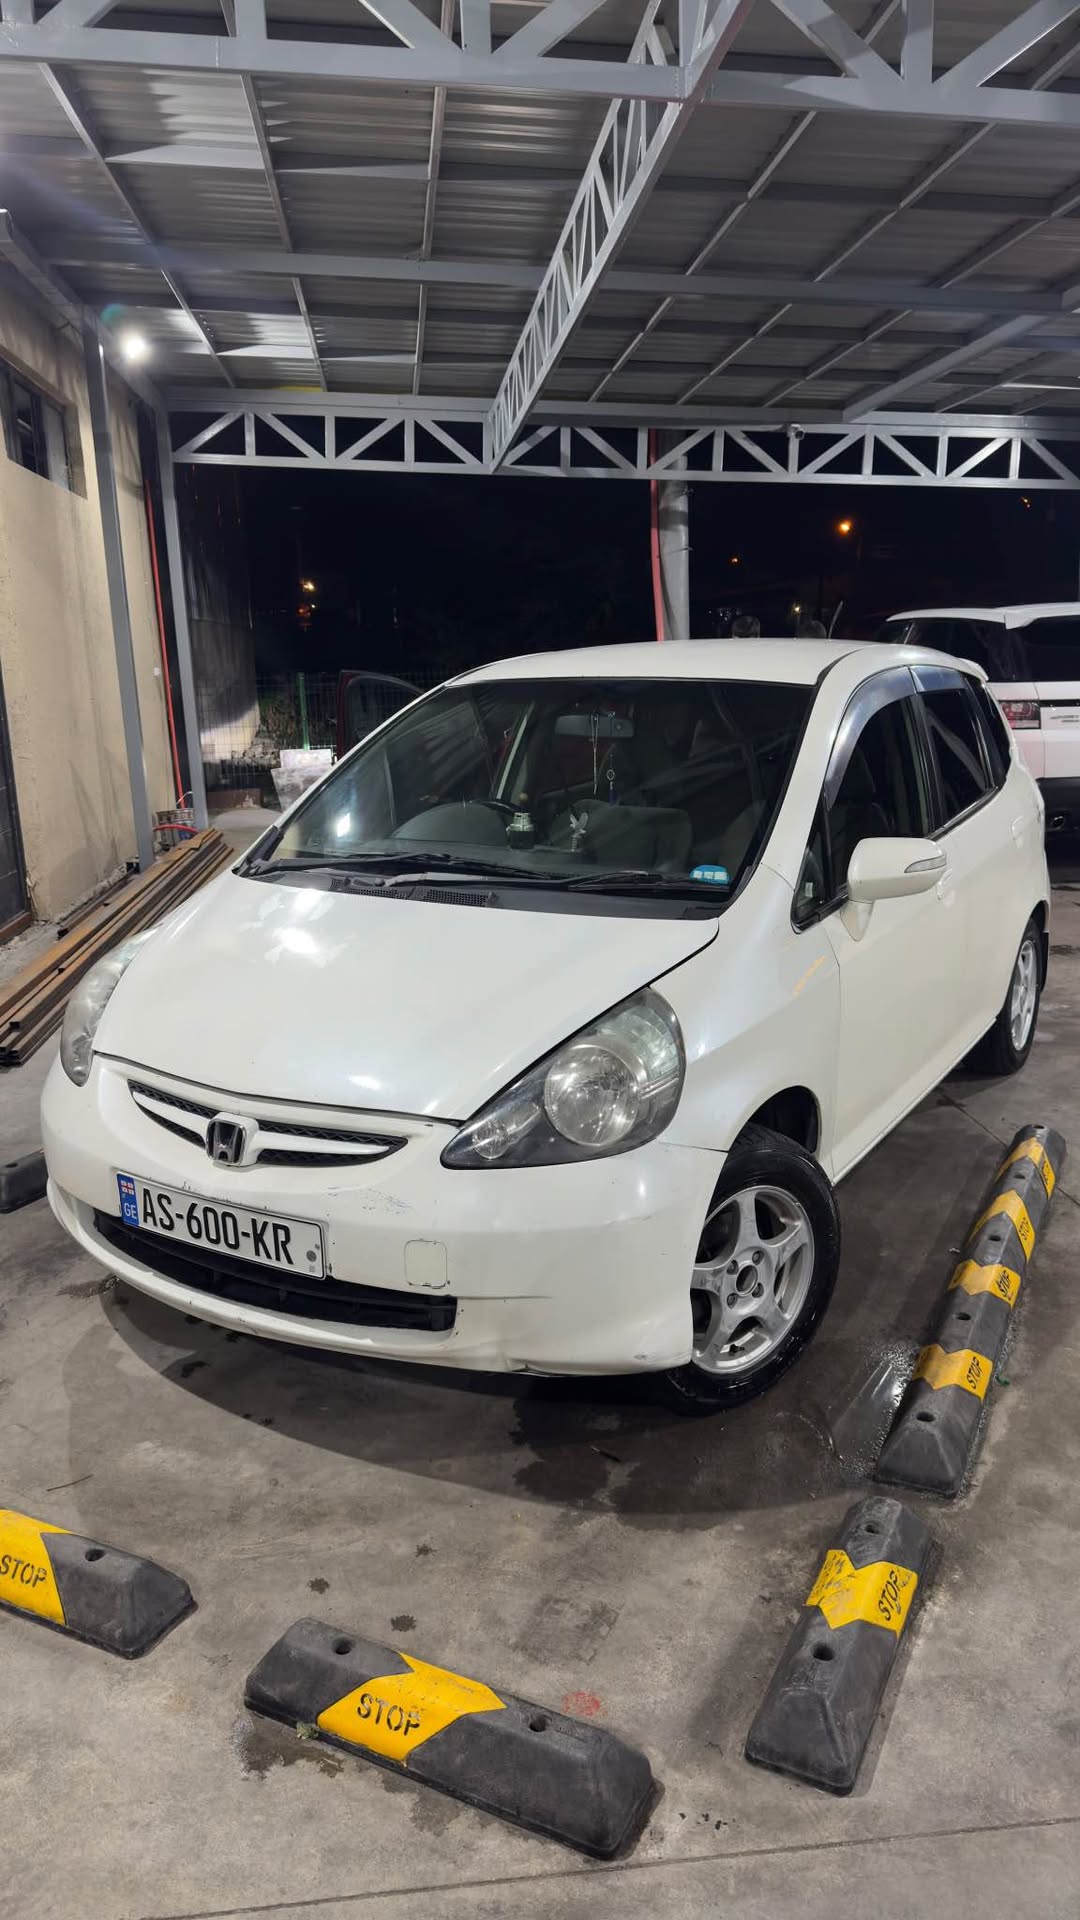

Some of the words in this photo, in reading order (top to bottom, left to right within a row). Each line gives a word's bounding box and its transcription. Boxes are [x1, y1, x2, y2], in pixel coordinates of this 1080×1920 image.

[124, 1202, 137, 1219] GE
[142, 1188, 294, 1265] AS-600-KR
[966, 1356, 983, 1389] STOP
[0, 1554, 47, 1588] STOP
[878, 1570, 902, 1621] STOP
[357, 1693, 420, 1736] STOP
